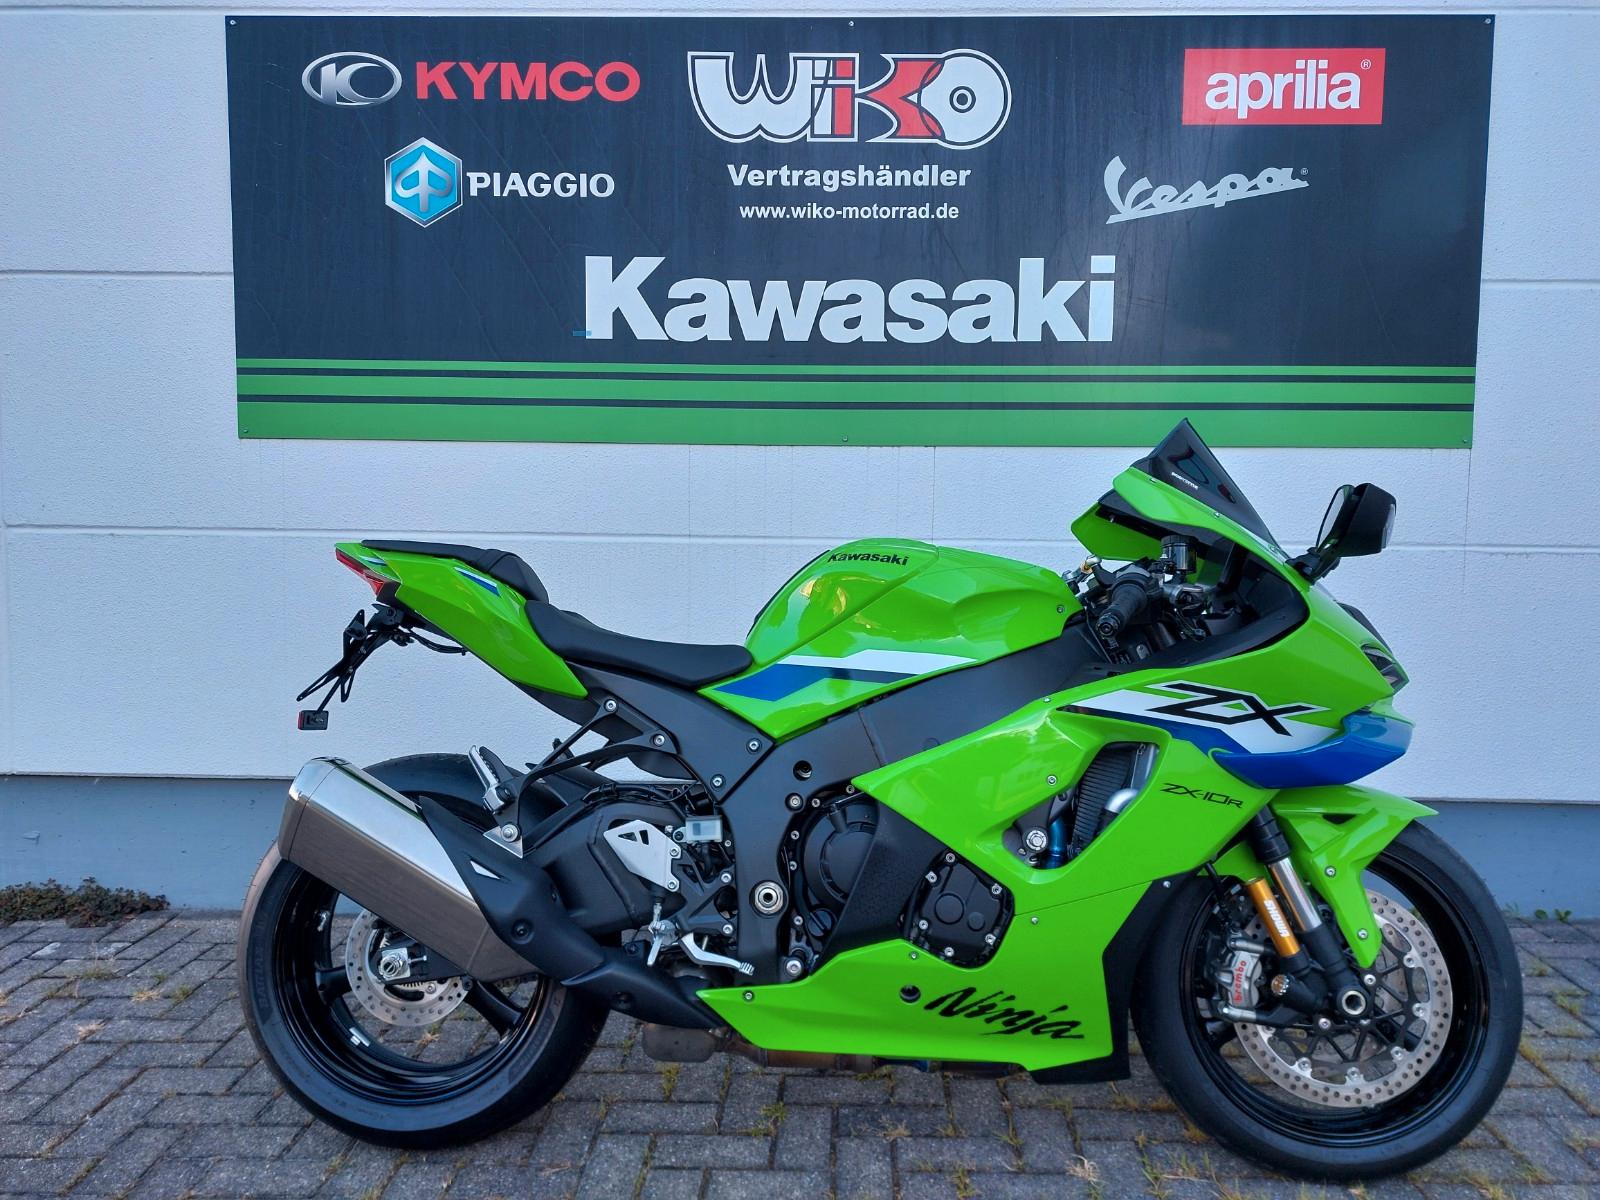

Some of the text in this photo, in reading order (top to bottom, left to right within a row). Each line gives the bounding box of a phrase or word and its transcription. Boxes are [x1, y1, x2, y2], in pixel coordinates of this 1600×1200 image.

[416, 61, 640, 102] KYMCO
[1205, 59, 1361, 119] aprilia
[467, 172, 615, 198] PIAGGIO
[727, 164, 971, 193] Vertragshändler
[1104, 156, 1309, 225] Vespa
[739, 203, 960, 220] www.wiko-motorrad.de
[585, 255, 1116, 343] Kawasaki
[828, 552, 909, 566] Kawasaki
[1146, 682, 1317, 737] ZX
[1161, 784, 1243, 809] ZX-10R
[1264, 900, 1290, 937] SHOWA
[1234, 960, 1247, 1004] brembo
[924, 986, 1085, 1041] Ninja
